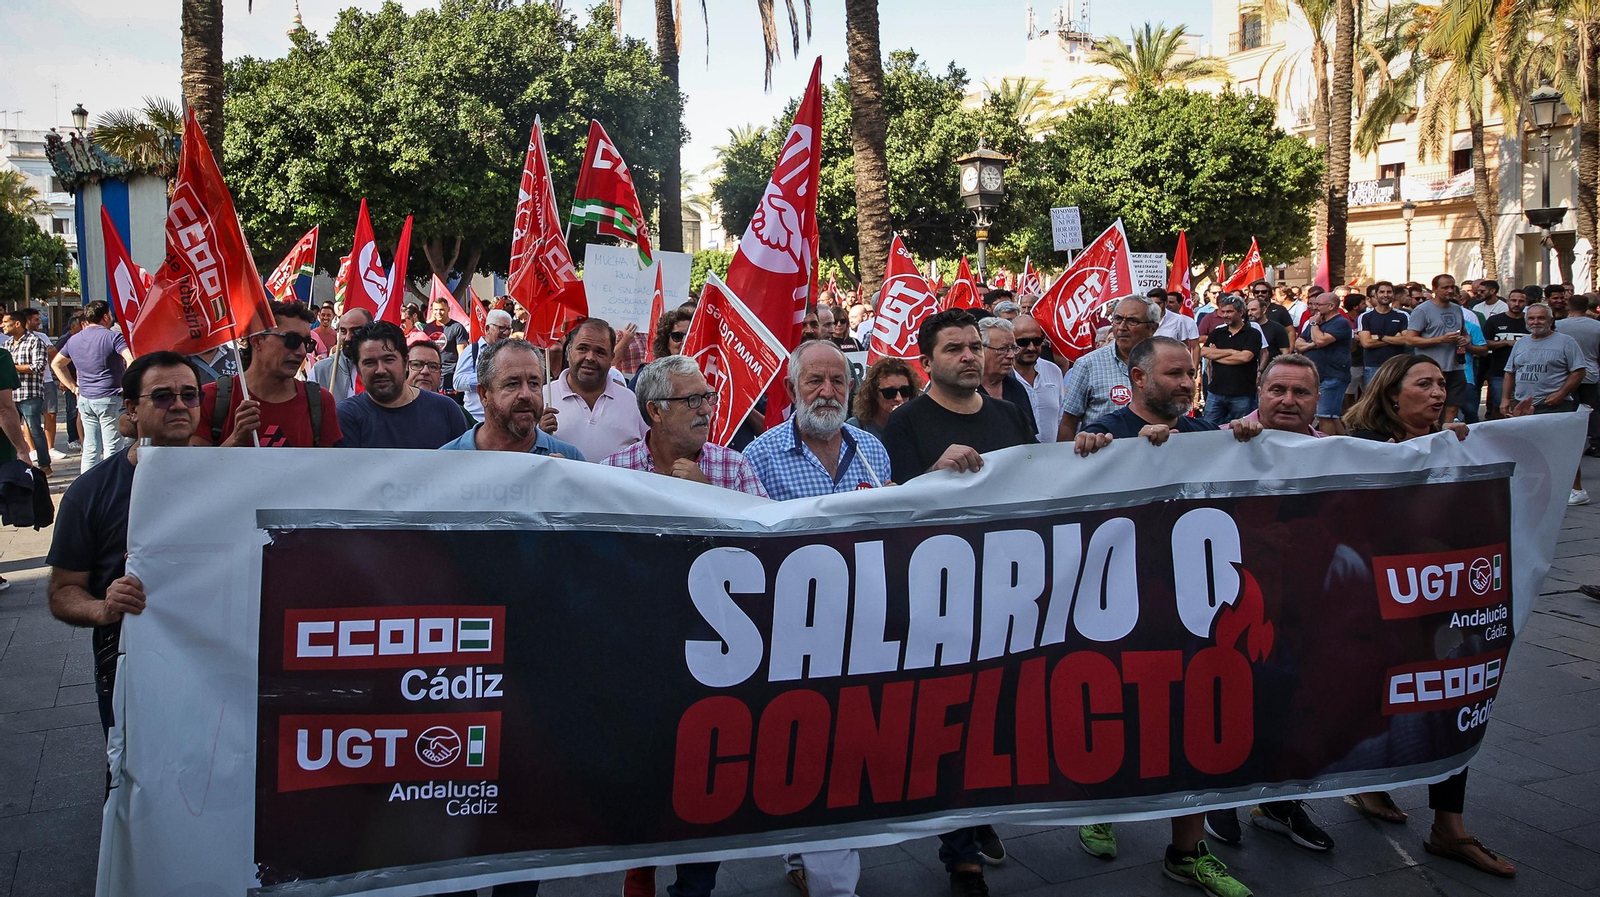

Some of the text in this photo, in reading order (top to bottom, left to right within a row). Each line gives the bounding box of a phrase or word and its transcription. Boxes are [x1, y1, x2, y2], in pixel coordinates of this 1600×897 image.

[594, 253, 628, 267] MUCHA
[602, 284, 613, 293] EL
[1137, 279, 1163, 288] USTOS
[872, 280, 925, 345] UGT
[1059, 272, 1103, 331] UGT
[1112, 388, 1129, 397] UGT
[684, 507, 1243, 688] SALARIO O
[1386, 562, 1465, 604] UGT
[1449, 604, 1508, 629] Andalucía
[1485, 623, 1508, 641] Cádiz
[297, 618, 454, 657] CCOO
[400, 666, 504, 701] Cádiz
[1389, 663, 1486, 704] CCOO
[1457, 698, 1493, 732] Cádi
[296, 728, 408, 770] UGT
[671, 645, 1255, 825] CONFLICTO
[388, 780, 499, 802] Andalucía
[446, 798, 499, 816] Cádiz
